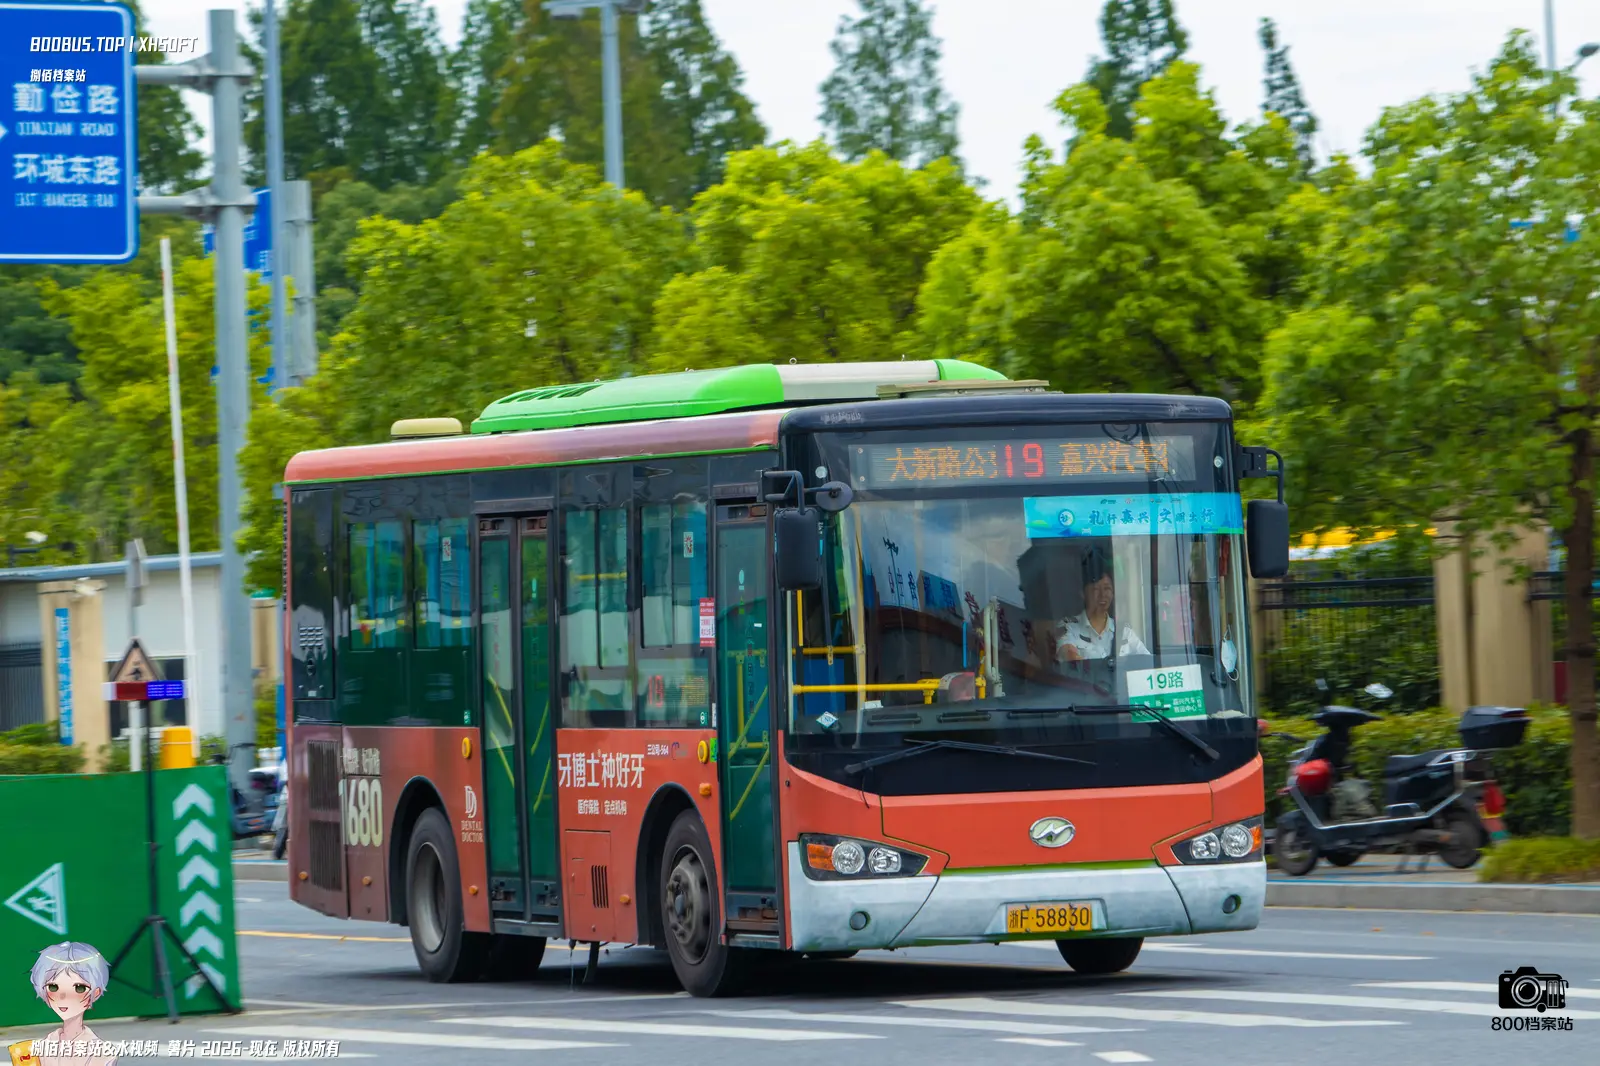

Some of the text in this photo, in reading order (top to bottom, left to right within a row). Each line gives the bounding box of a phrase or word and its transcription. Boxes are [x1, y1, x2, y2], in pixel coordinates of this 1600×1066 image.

[13, 83, 119, 114] 勤俭路
[13, 153, 120, 185] 环城东路
[1004, 442, 1044, 479] 19
[1146, 671, 1184, 690] 19路
[338, 778, 383, 847] 1680
[461, 820, 483, 831] DENTAL
[461, 831, 484, 843] DOCTOR
